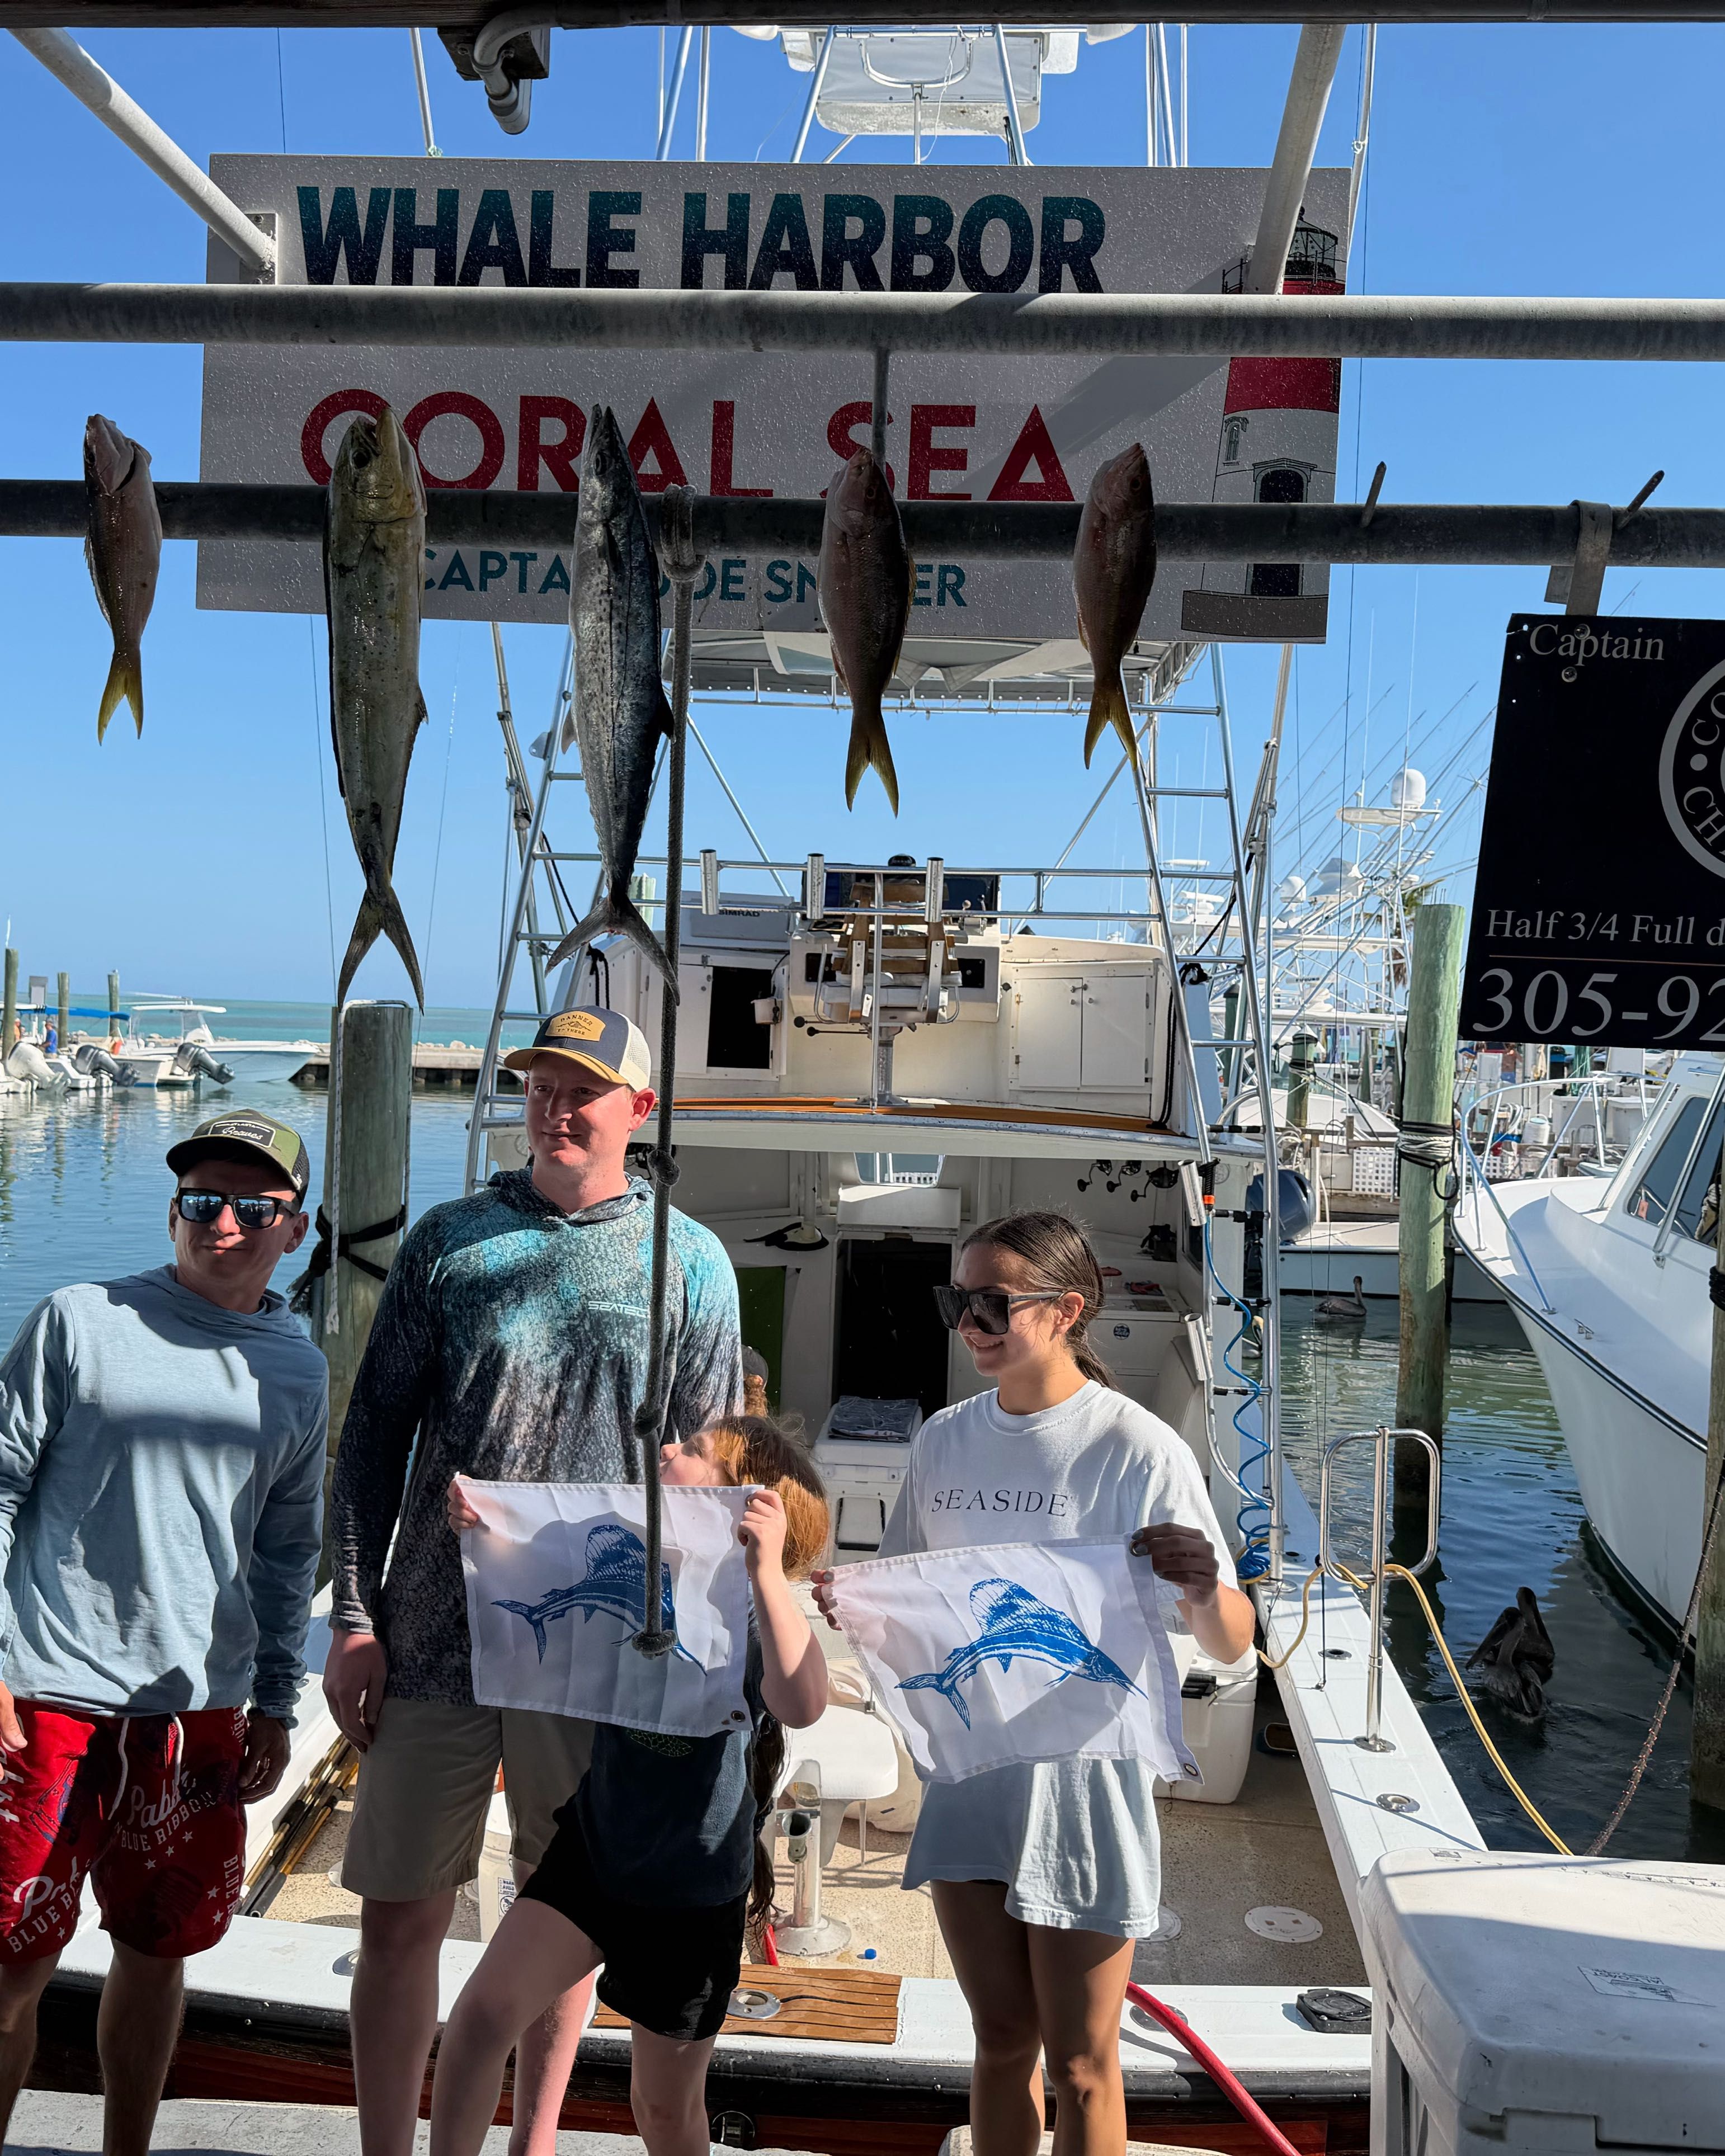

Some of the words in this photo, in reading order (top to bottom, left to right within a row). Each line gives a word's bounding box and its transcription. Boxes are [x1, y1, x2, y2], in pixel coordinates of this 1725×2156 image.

[296, 185, 642, 289] WHALE
[680, 191, 1106, 294] HARBOR
[424, 548, 571, 596] APTA
[763, 559, 968, 607] SNER
[1529, 622, 1665, 667] Captain
[1484, 909, 1564, 940] Half
[1567, 912, 1619, 941] 3/4
[1628, 914, 1695, 945] Full
[931, 1489, 1068, 1517] SEASIDE
[121, 1829, 152, 1852] BLUE
[6, 1905, 62, 1954] BLUE
